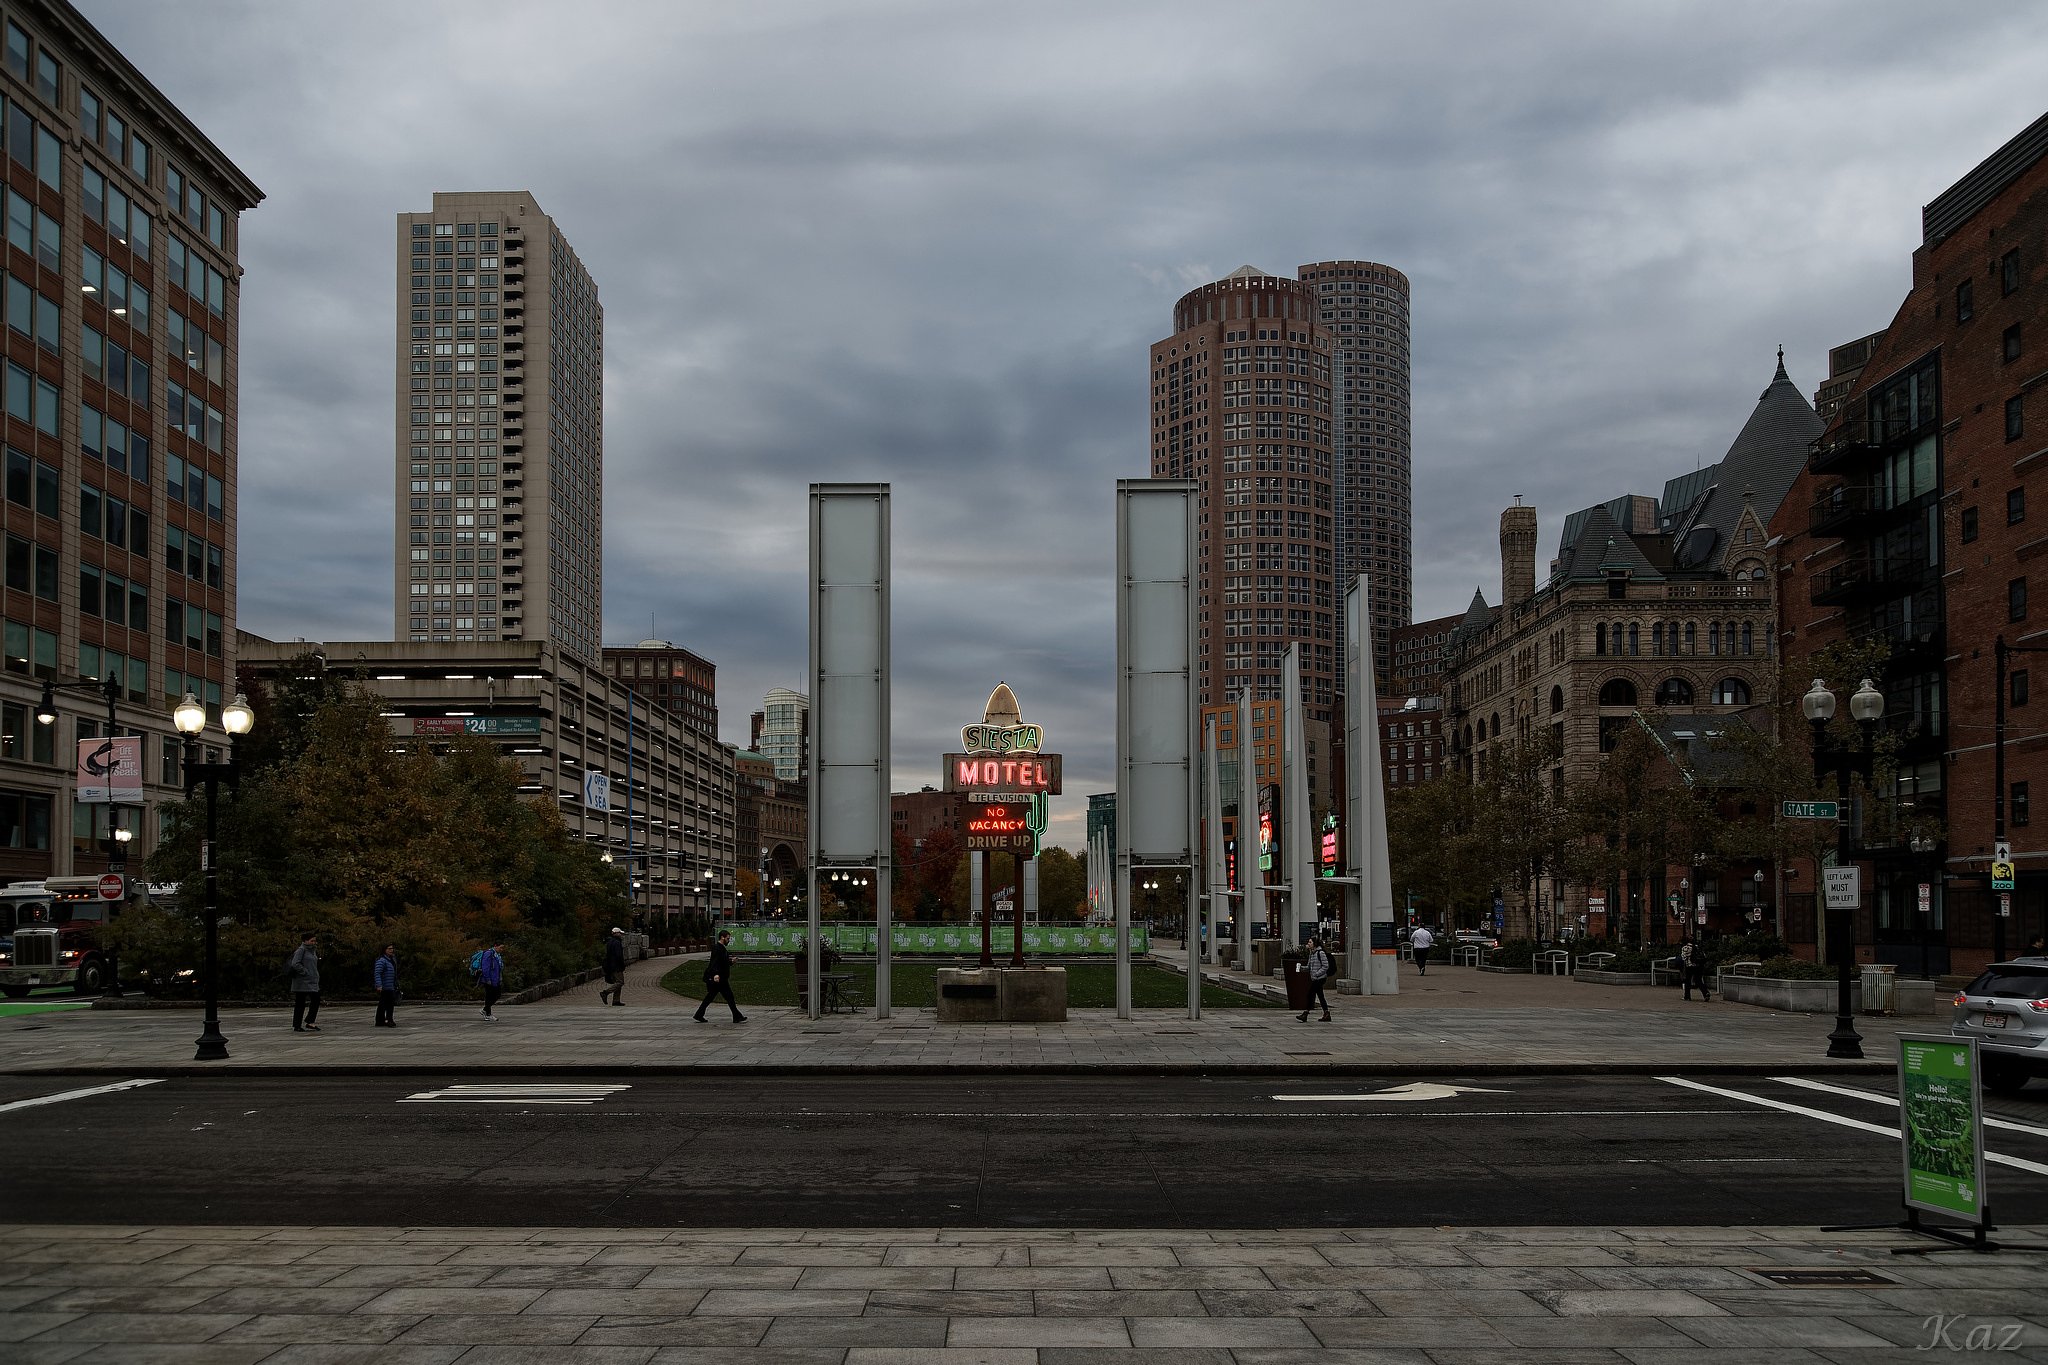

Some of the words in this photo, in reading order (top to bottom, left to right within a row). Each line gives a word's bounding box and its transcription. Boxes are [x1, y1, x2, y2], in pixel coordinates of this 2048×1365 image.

[967, 727, 1038, 750] SIESTA
[960, 761, 1048, 786] MOTEL
[595, 775, 607, 787] OPEN
[595, 795, 607, 810] SEA
[975, 794, 1031, 802] TELEVISION
[987, 808, 1005, 817] NO
[1788, 803, 1815, 816] STATE
[970, 821, 1024, 830] VACANCY
[967, 836, 1008, 848] DRIVE
[1013, 835, 1031, 847] UP
[1831, 883, 1848, 891] MUST
[1929, 1084, 1948, 1094] Hello!
